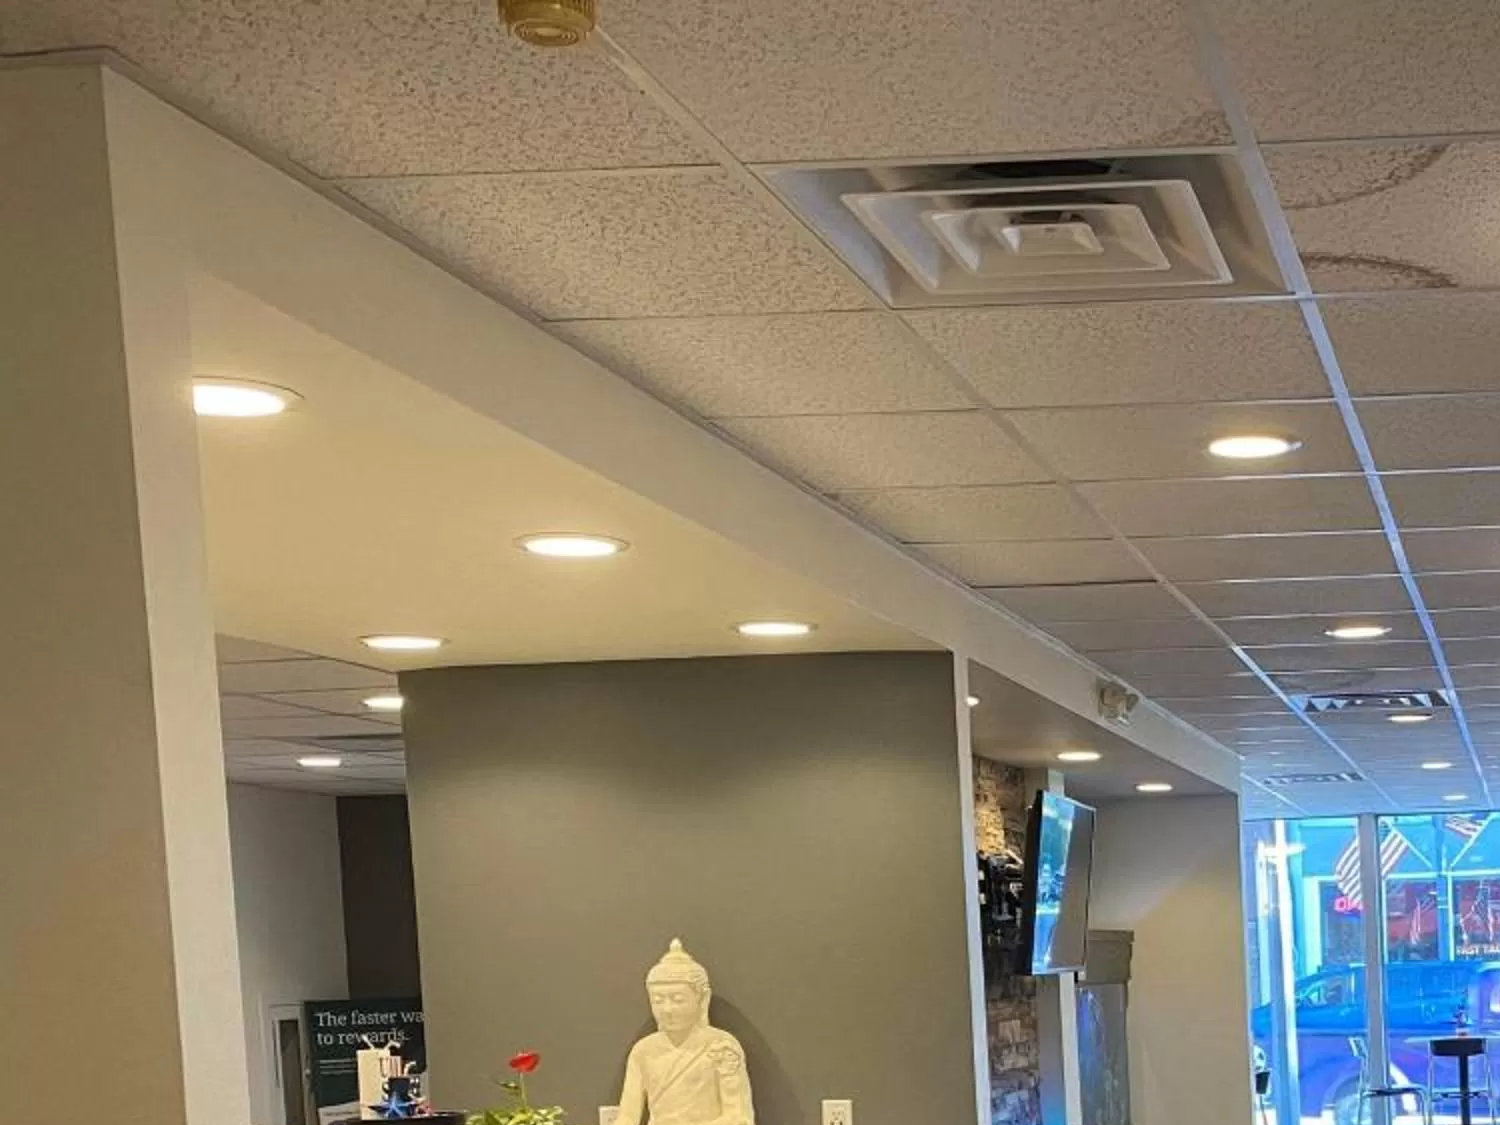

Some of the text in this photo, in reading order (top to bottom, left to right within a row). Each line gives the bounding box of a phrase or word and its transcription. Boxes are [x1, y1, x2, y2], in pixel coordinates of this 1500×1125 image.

[315, 1010, 424, 1027] The faster wa
[317, 1032, 334, 1045] to
